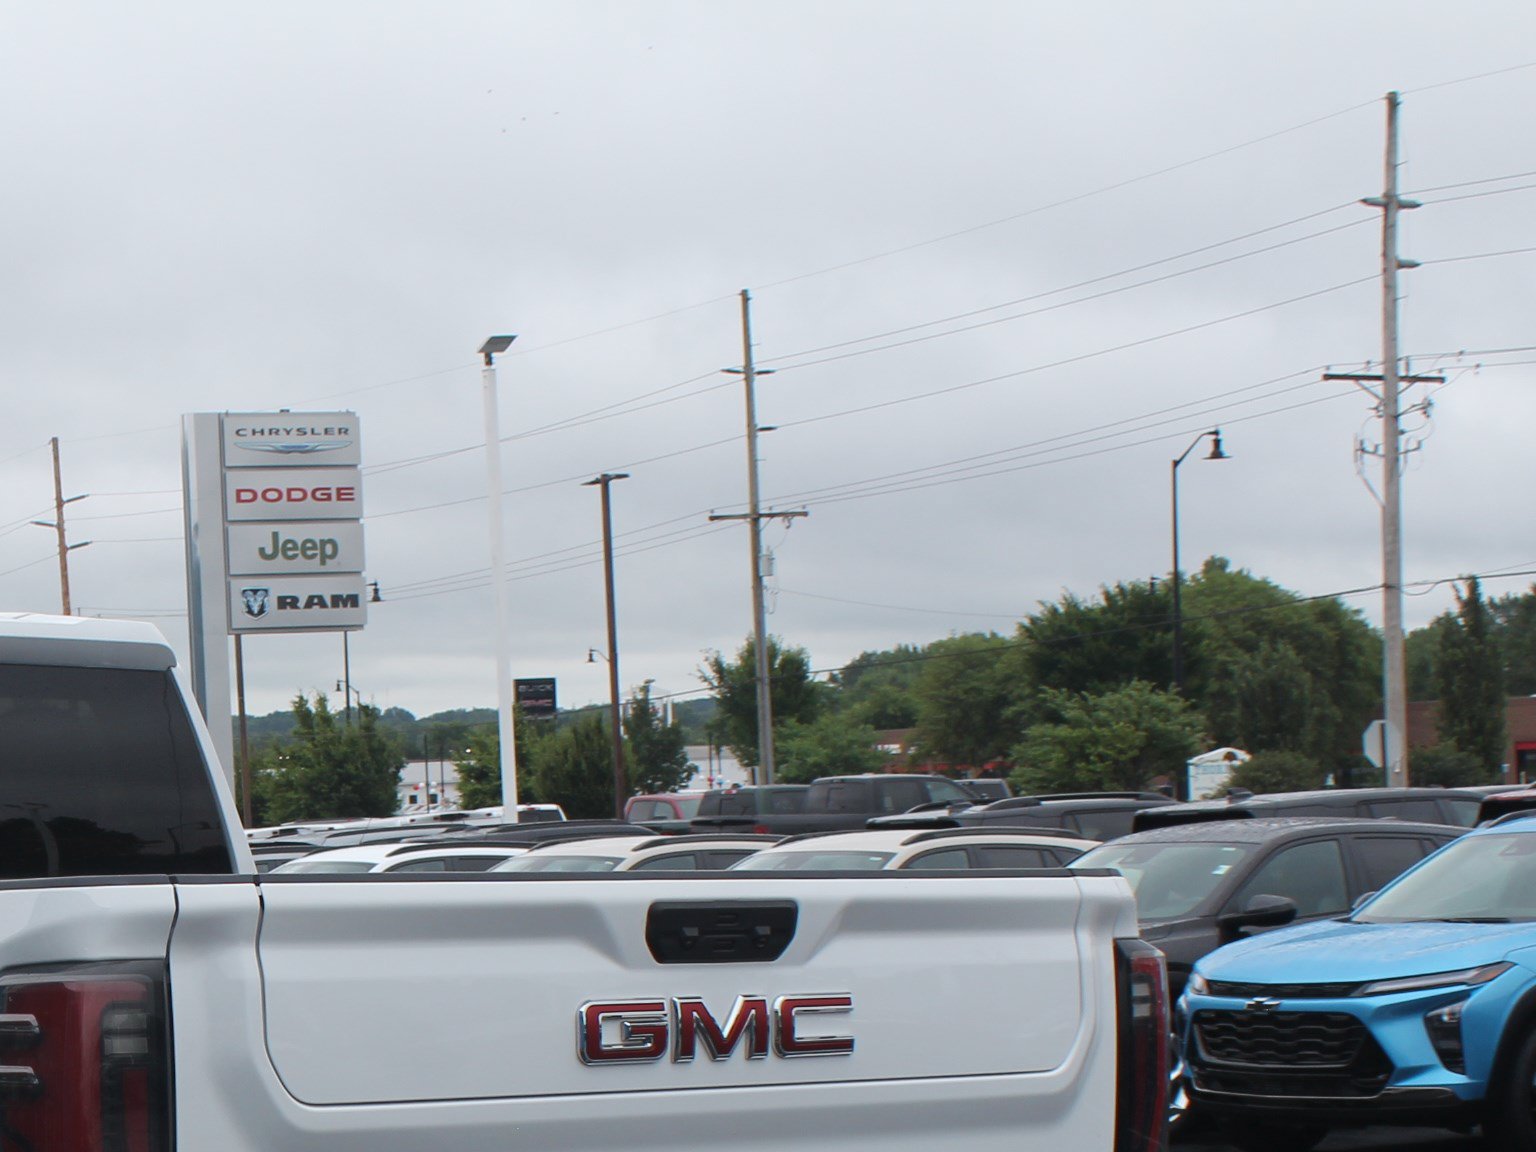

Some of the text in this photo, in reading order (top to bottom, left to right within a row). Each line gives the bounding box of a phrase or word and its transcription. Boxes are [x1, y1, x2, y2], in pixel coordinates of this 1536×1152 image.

[235, 427, 350, 437] CHRYSLER
[235, 486, 356, 504] DODGE
[258, 531, 339, 566] Jeep
[277, 593, 360, 610] RAM
[576, 991, 855, 1067] GMC
